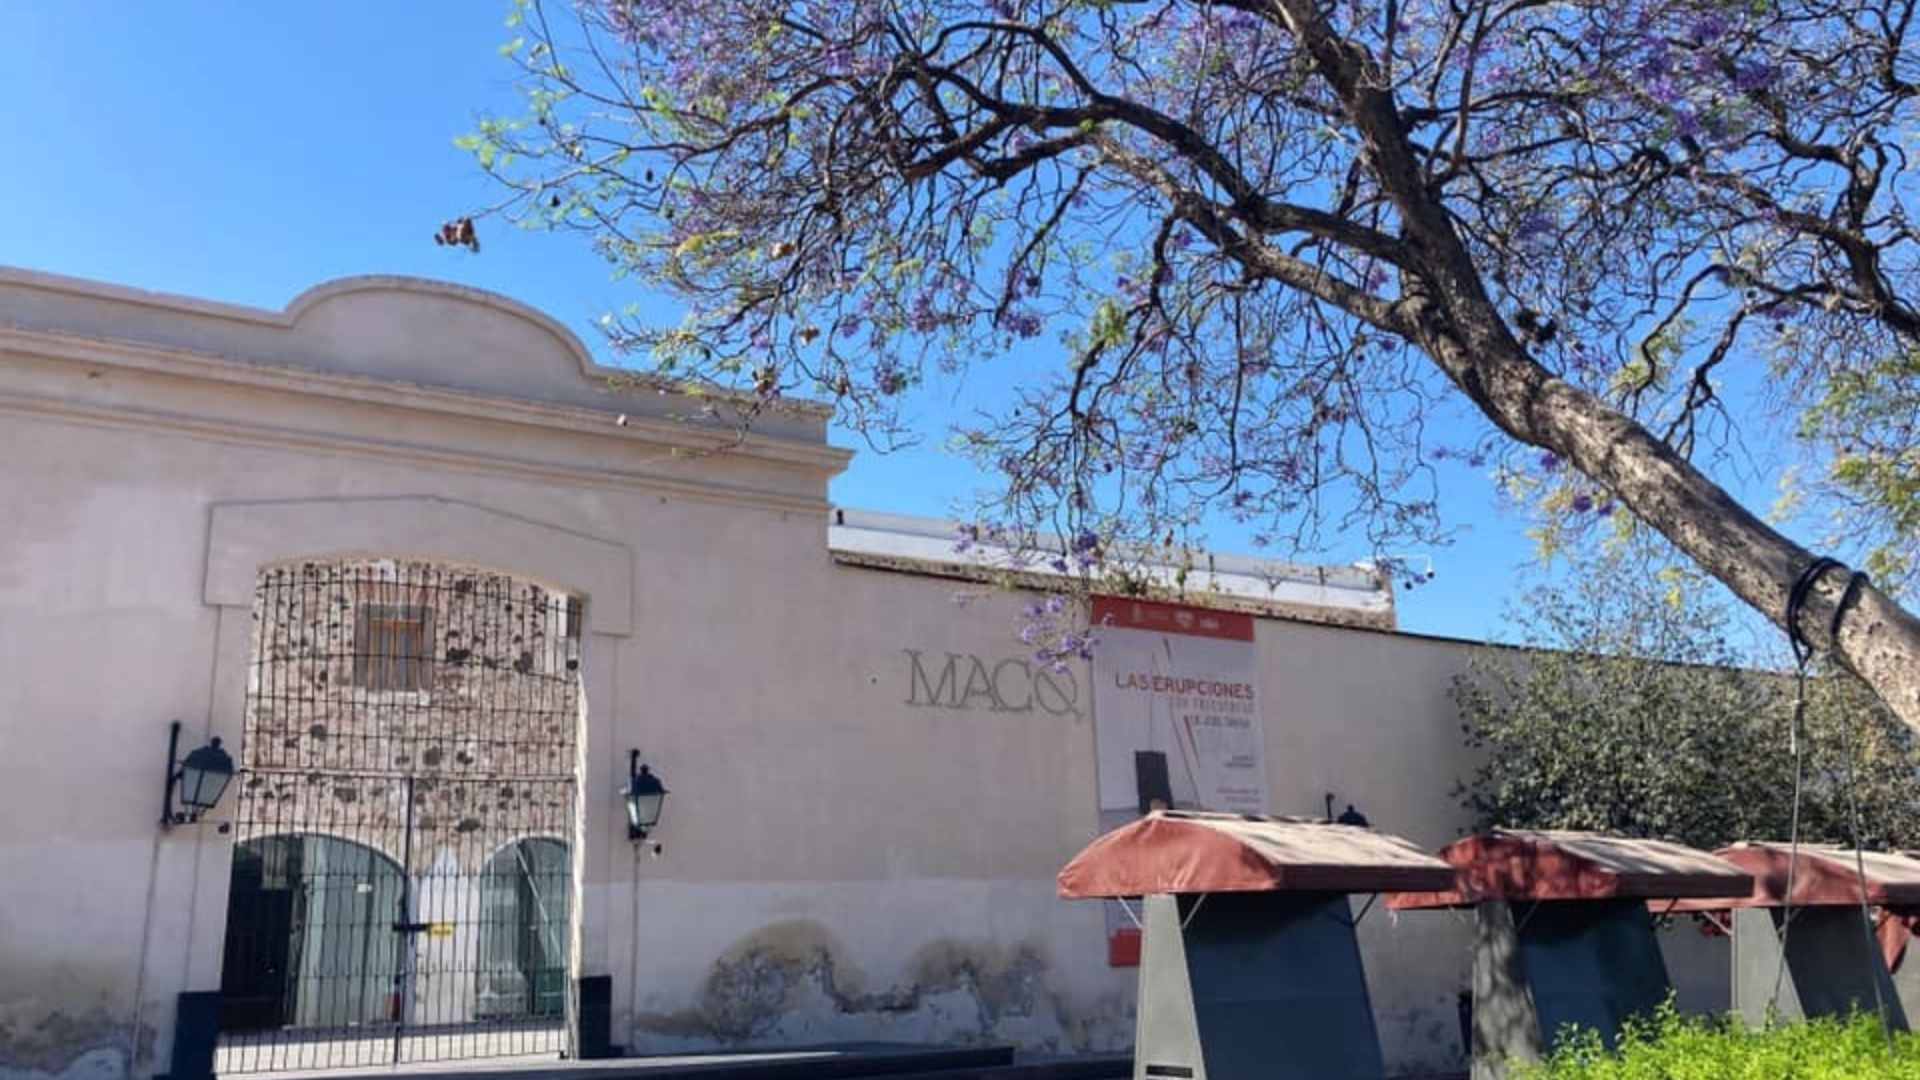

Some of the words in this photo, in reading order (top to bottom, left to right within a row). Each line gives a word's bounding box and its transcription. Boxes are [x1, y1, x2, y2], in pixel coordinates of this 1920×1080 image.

[903, 649, 1086, 724] MACQ
[1115, 671, 1149, 691] LAS
[1152, 676, 1254, 699] ERUPCIONES
